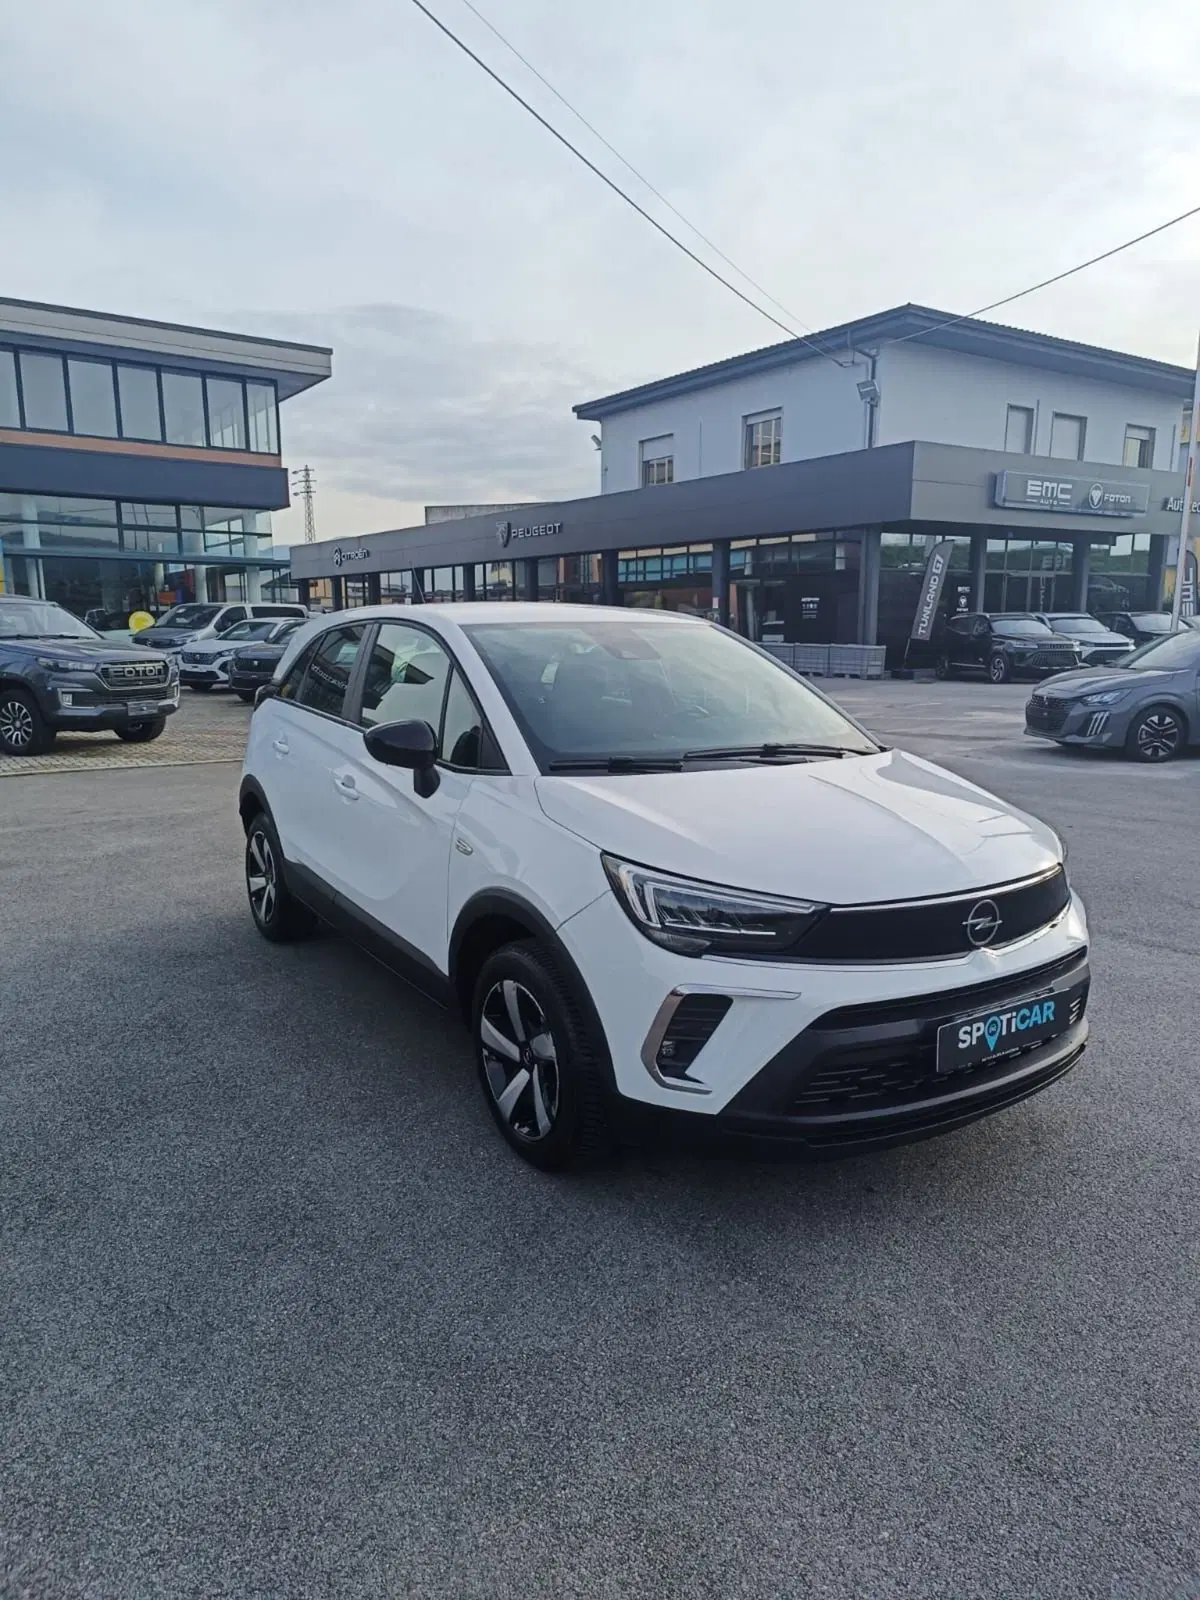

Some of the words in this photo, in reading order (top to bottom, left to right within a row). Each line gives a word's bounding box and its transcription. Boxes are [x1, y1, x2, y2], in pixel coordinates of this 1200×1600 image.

[1026, 480, 1073, 499] EMC
[1103, 493, 1132, 503] FOTON
[511, 522, 561, 539] PEUGEOT
[918, 575, 940, 636] TUNLAND
[109, 665, 164, 678] FOTON
